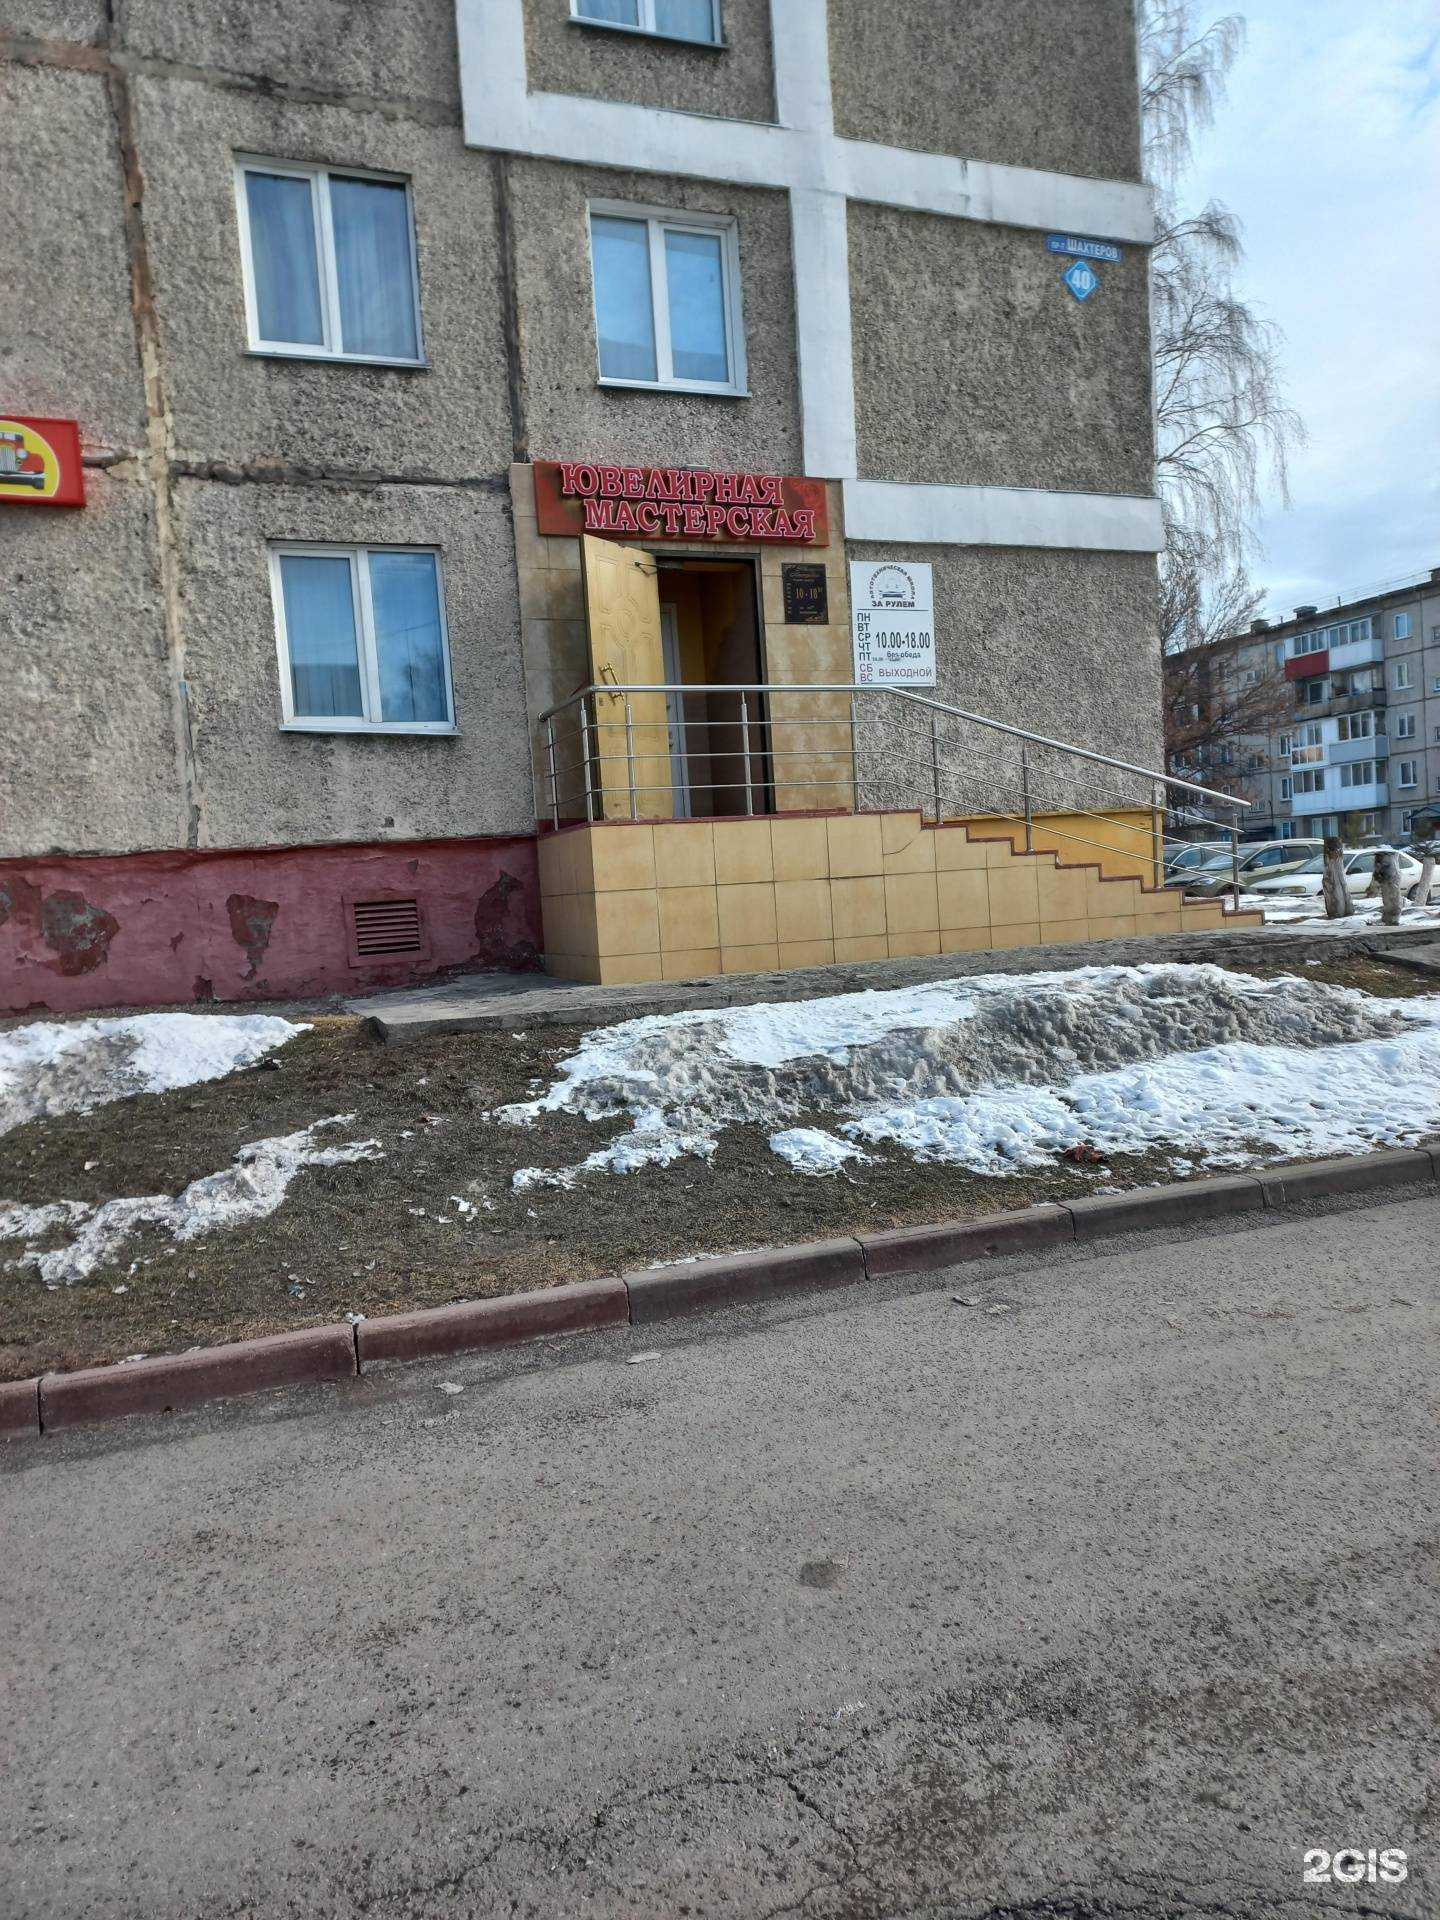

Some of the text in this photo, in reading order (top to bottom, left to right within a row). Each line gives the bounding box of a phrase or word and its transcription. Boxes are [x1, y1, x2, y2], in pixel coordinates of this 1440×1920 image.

[1066, 238, 1118, 259] ШАХТЕРОВ
[1072, 269, 1091, 290] 40
[560, 463, 785, 506] ЮВЕЛИРНАЯ
[584, 499, 816, 538] МАСТЕРСКАЯ
[872, 600, 915, 608] ЗА РУЛЕМ
[857, 612, 871, 622] ПН
[857, 622, 870, 632] ВТ
[857, 632, 871, 642] СР
[875, 631, 931, 649] 10.00-18.00
[858, 642, 871, 652] ЧТ
[859, 652, 872, 661] ПТ
[860, 663, 873, 673] СБ
[879, 667, 933, 678] ВЫХОДНОЙ
[860, 673, 873, 682] ВС
